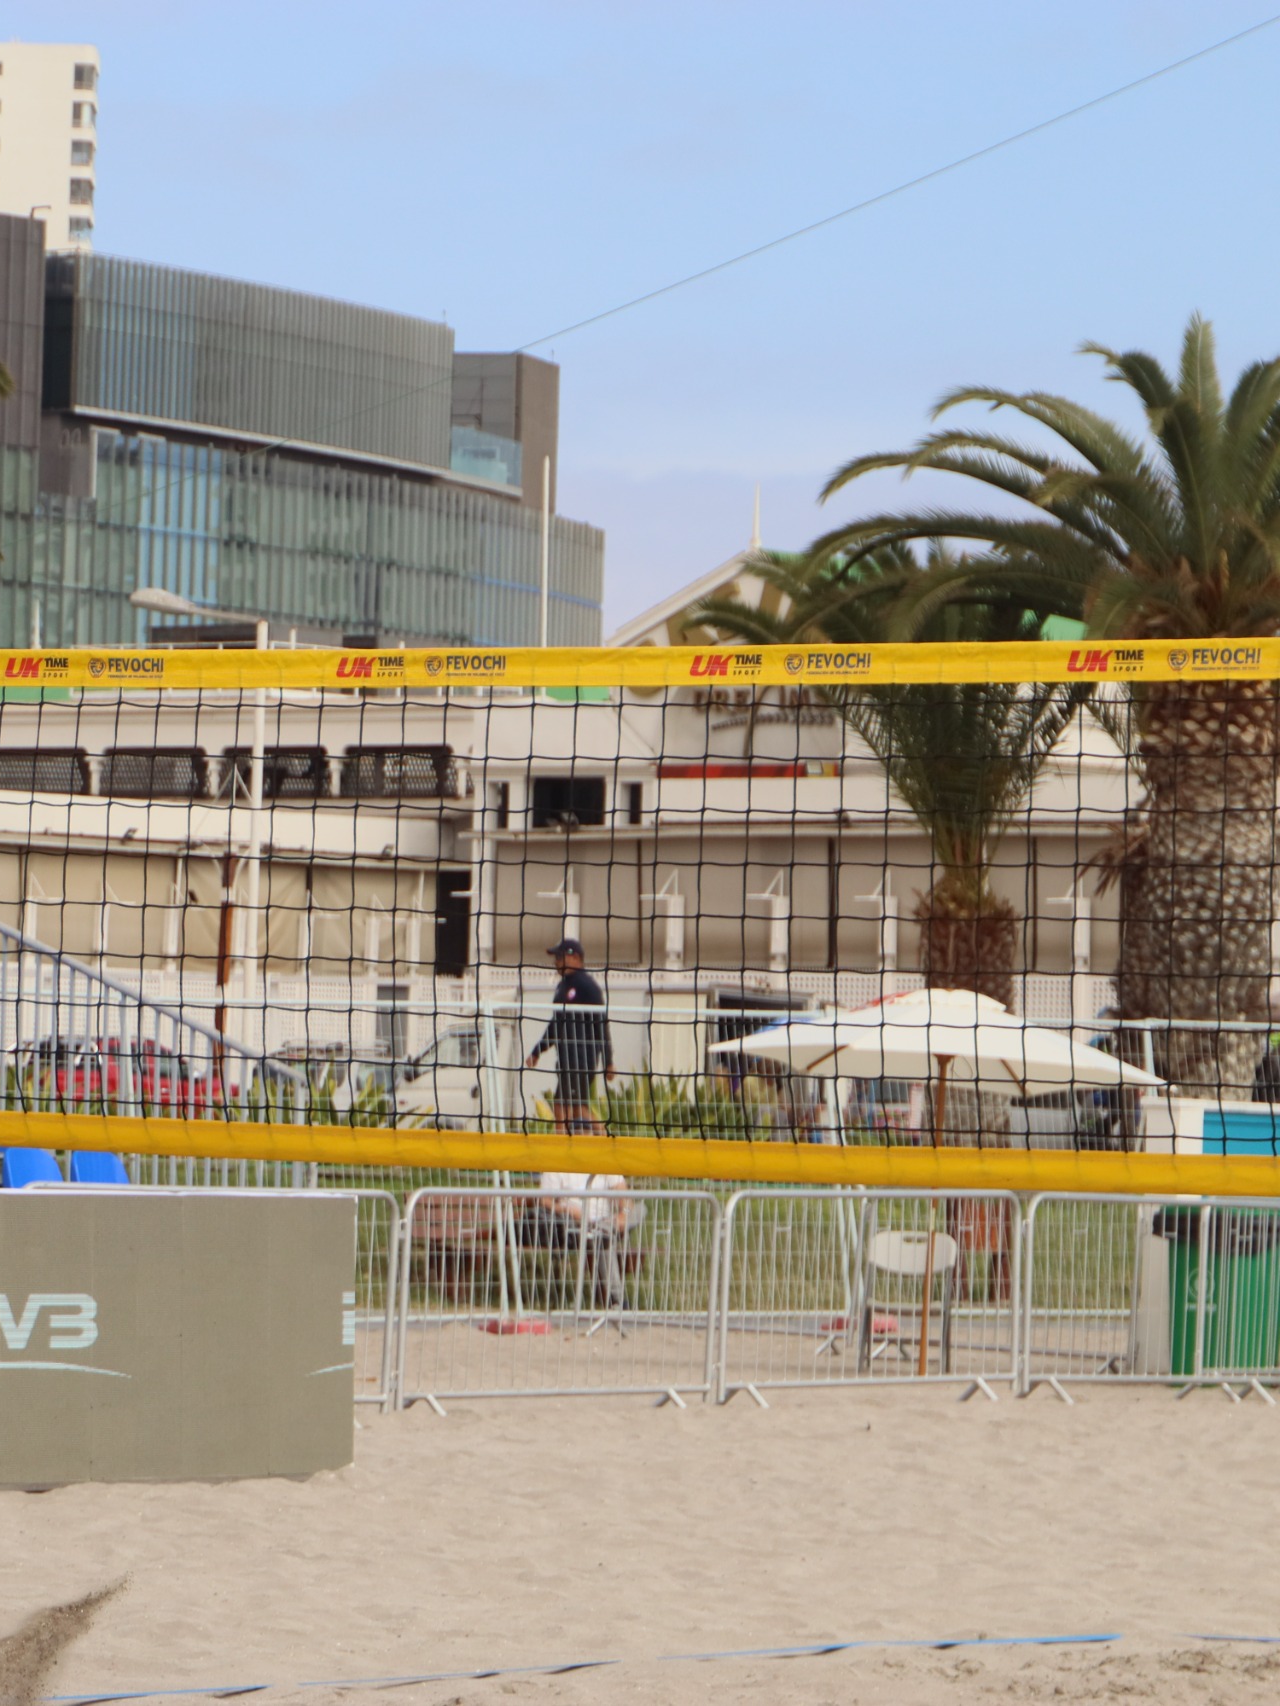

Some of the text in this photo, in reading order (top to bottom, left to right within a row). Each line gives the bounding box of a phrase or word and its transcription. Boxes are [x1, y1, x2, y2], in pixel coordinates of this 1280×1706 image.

[108, 658, 164, 672] FEVOCHI
[446, 655, 506, 670] FEVOCHI
[689, 654, 762, 676] UK TIME
[807, 653, 871, 669] FEVOCHI
[1067, 649, 1144, 672] UK TIME
[1192, 648, 1260, 664] FEVOCHI
[5, 658, 68, 678] UK TIME
[336, 656, 404, 678] UK TIME
